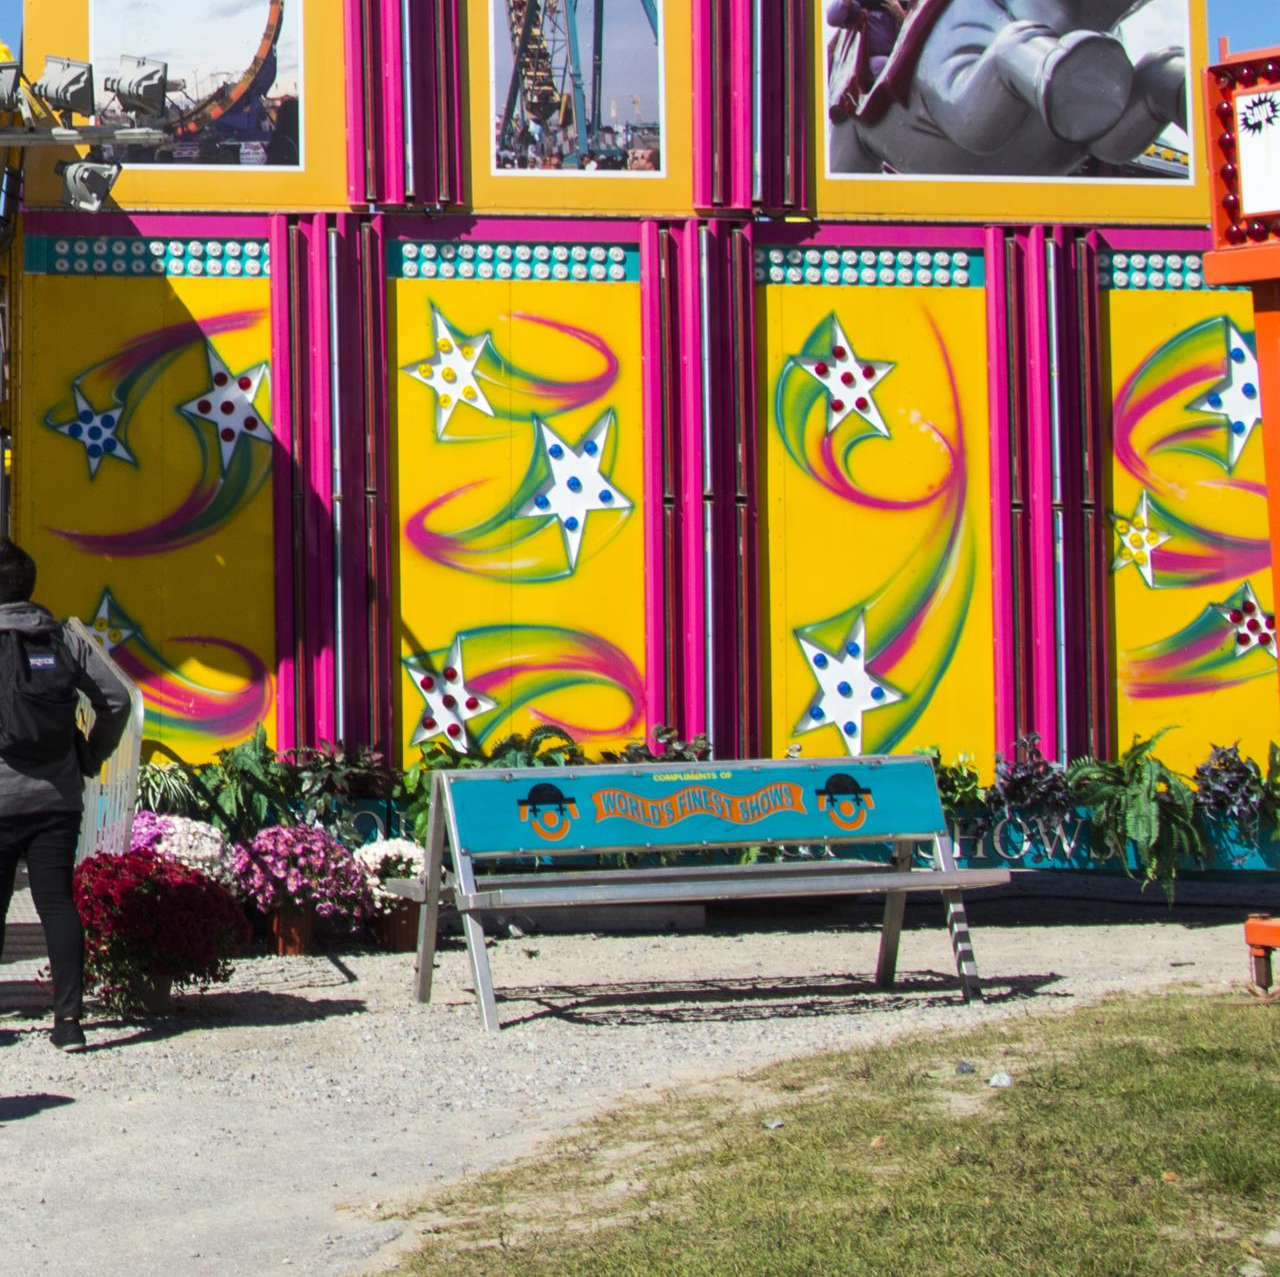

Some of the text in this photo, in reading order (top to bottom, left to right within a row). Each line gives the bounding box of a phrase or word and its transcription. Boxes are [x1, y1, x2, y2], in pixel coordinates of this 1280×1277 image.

[600, 784, 794, 824] WORLD'S FINEST SHOWS
